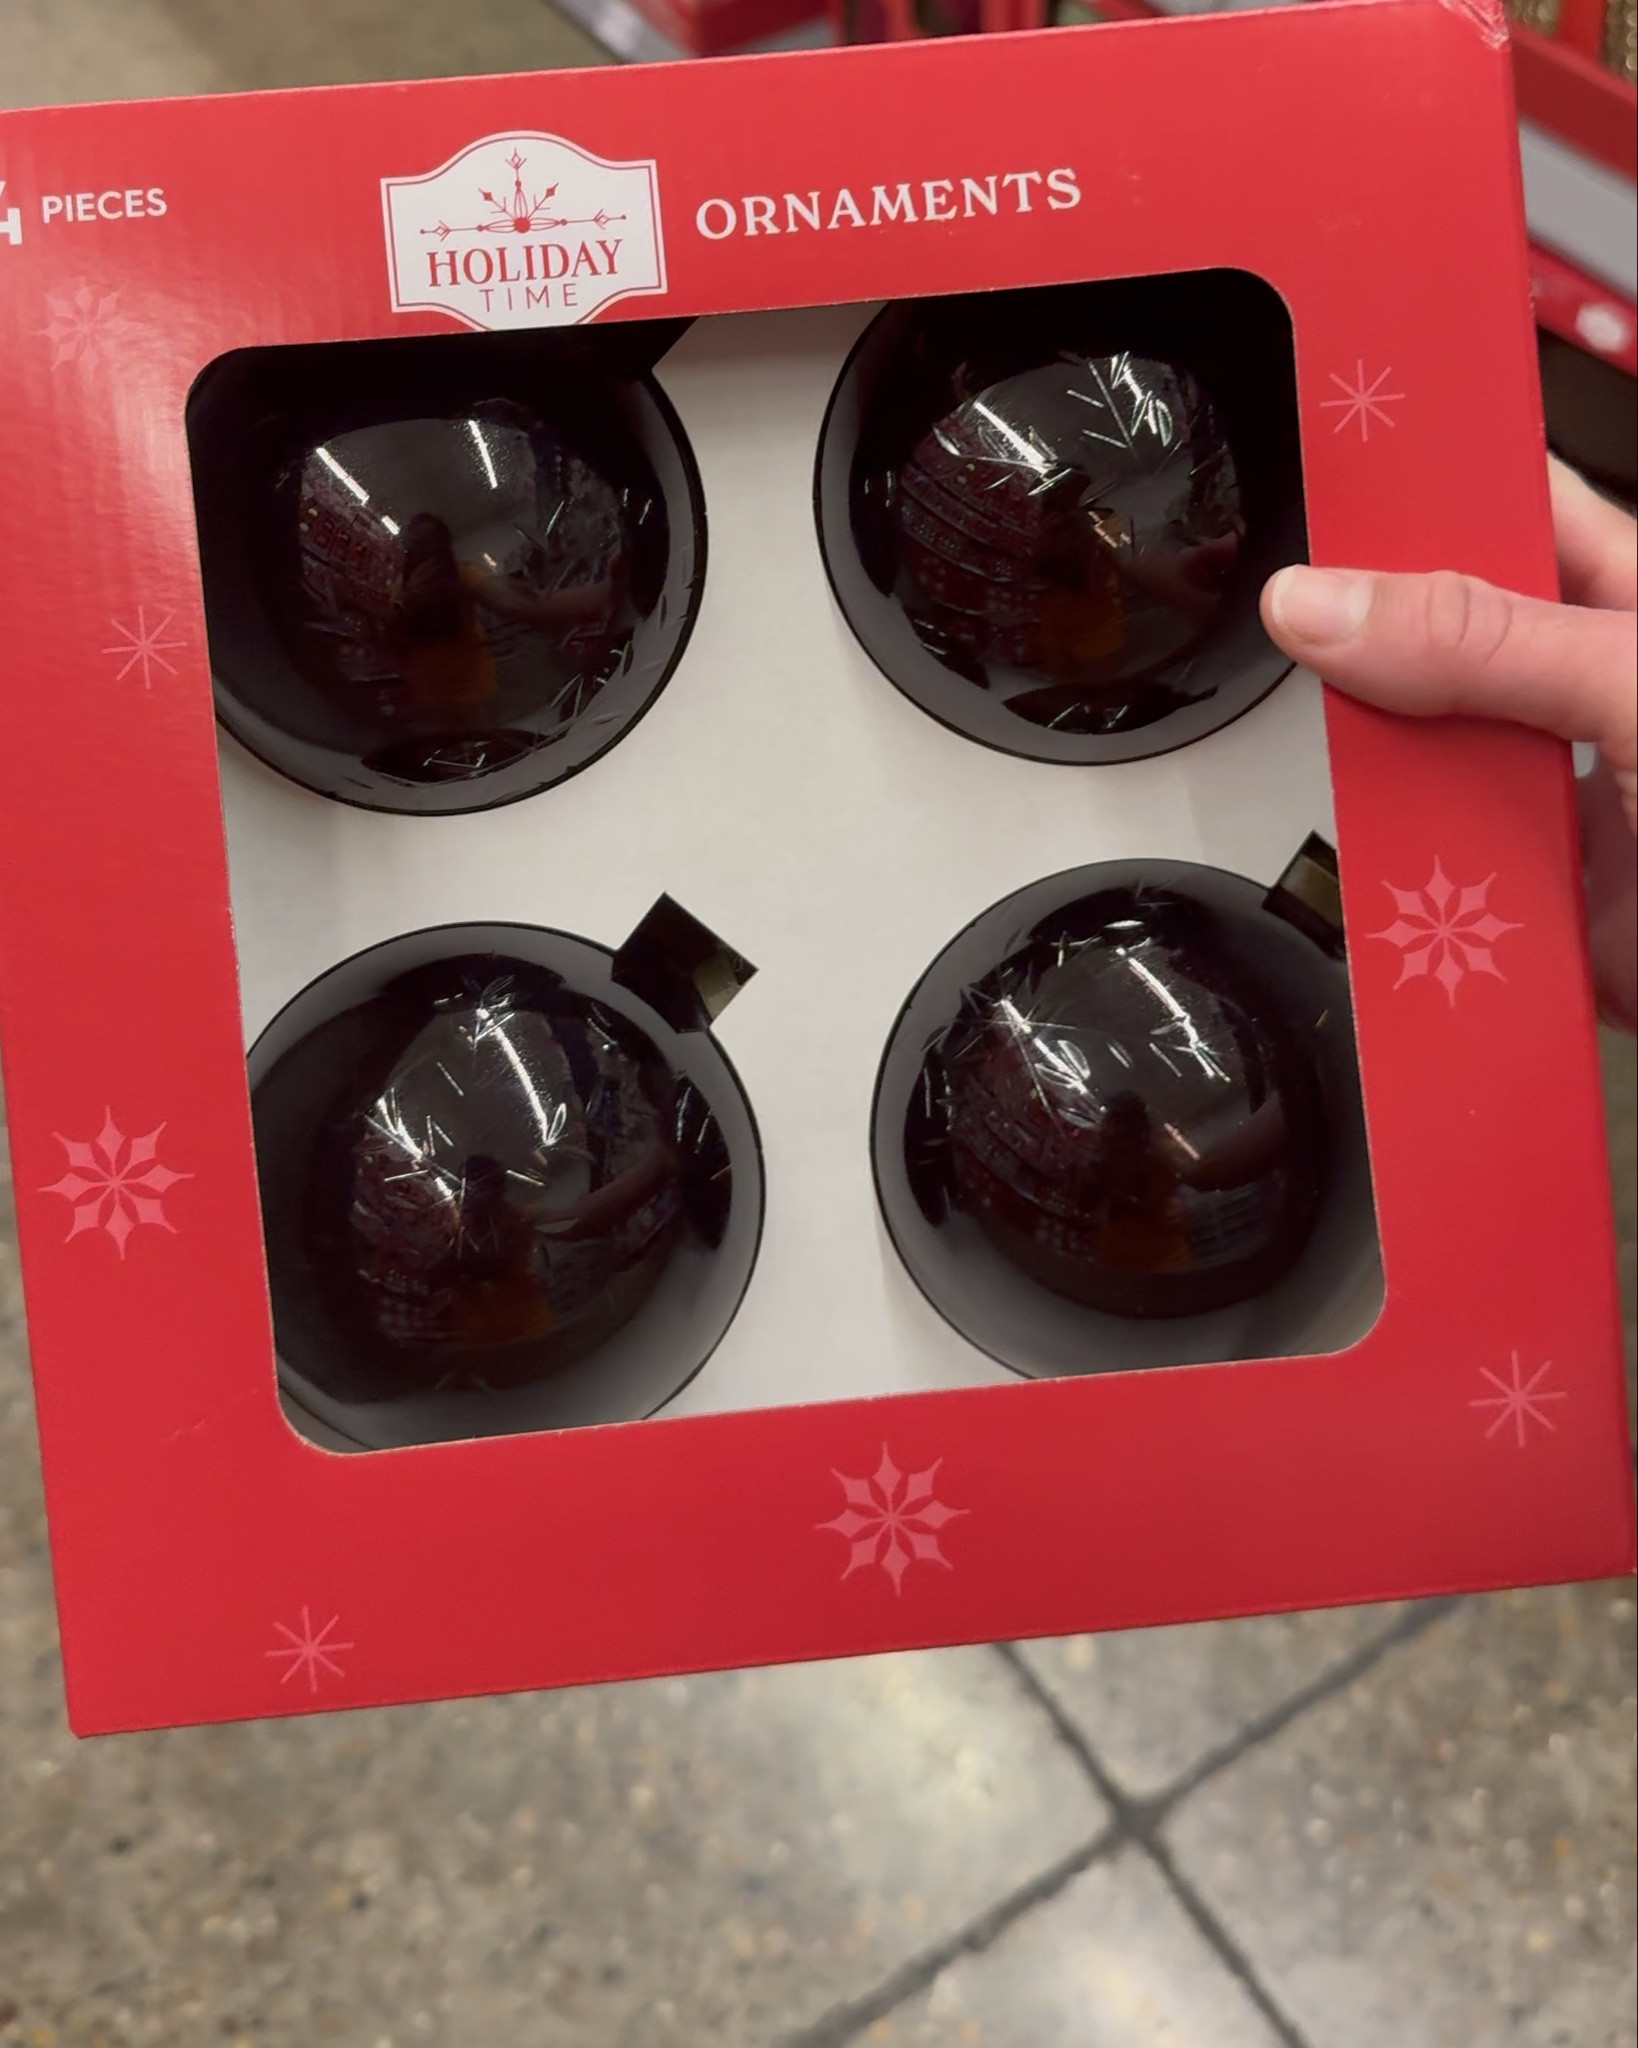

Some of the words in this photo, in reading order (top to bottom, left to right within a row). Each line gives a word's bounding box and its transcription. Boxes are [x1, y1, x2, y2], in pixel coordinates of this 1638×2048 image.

[42, 188, 168, 223] PIECES
[696, 168, 1082, 240] ORNAMENTS
[427, 239, 623, 287] HOLIDAY
[479, 283, 578, 312] TIME
